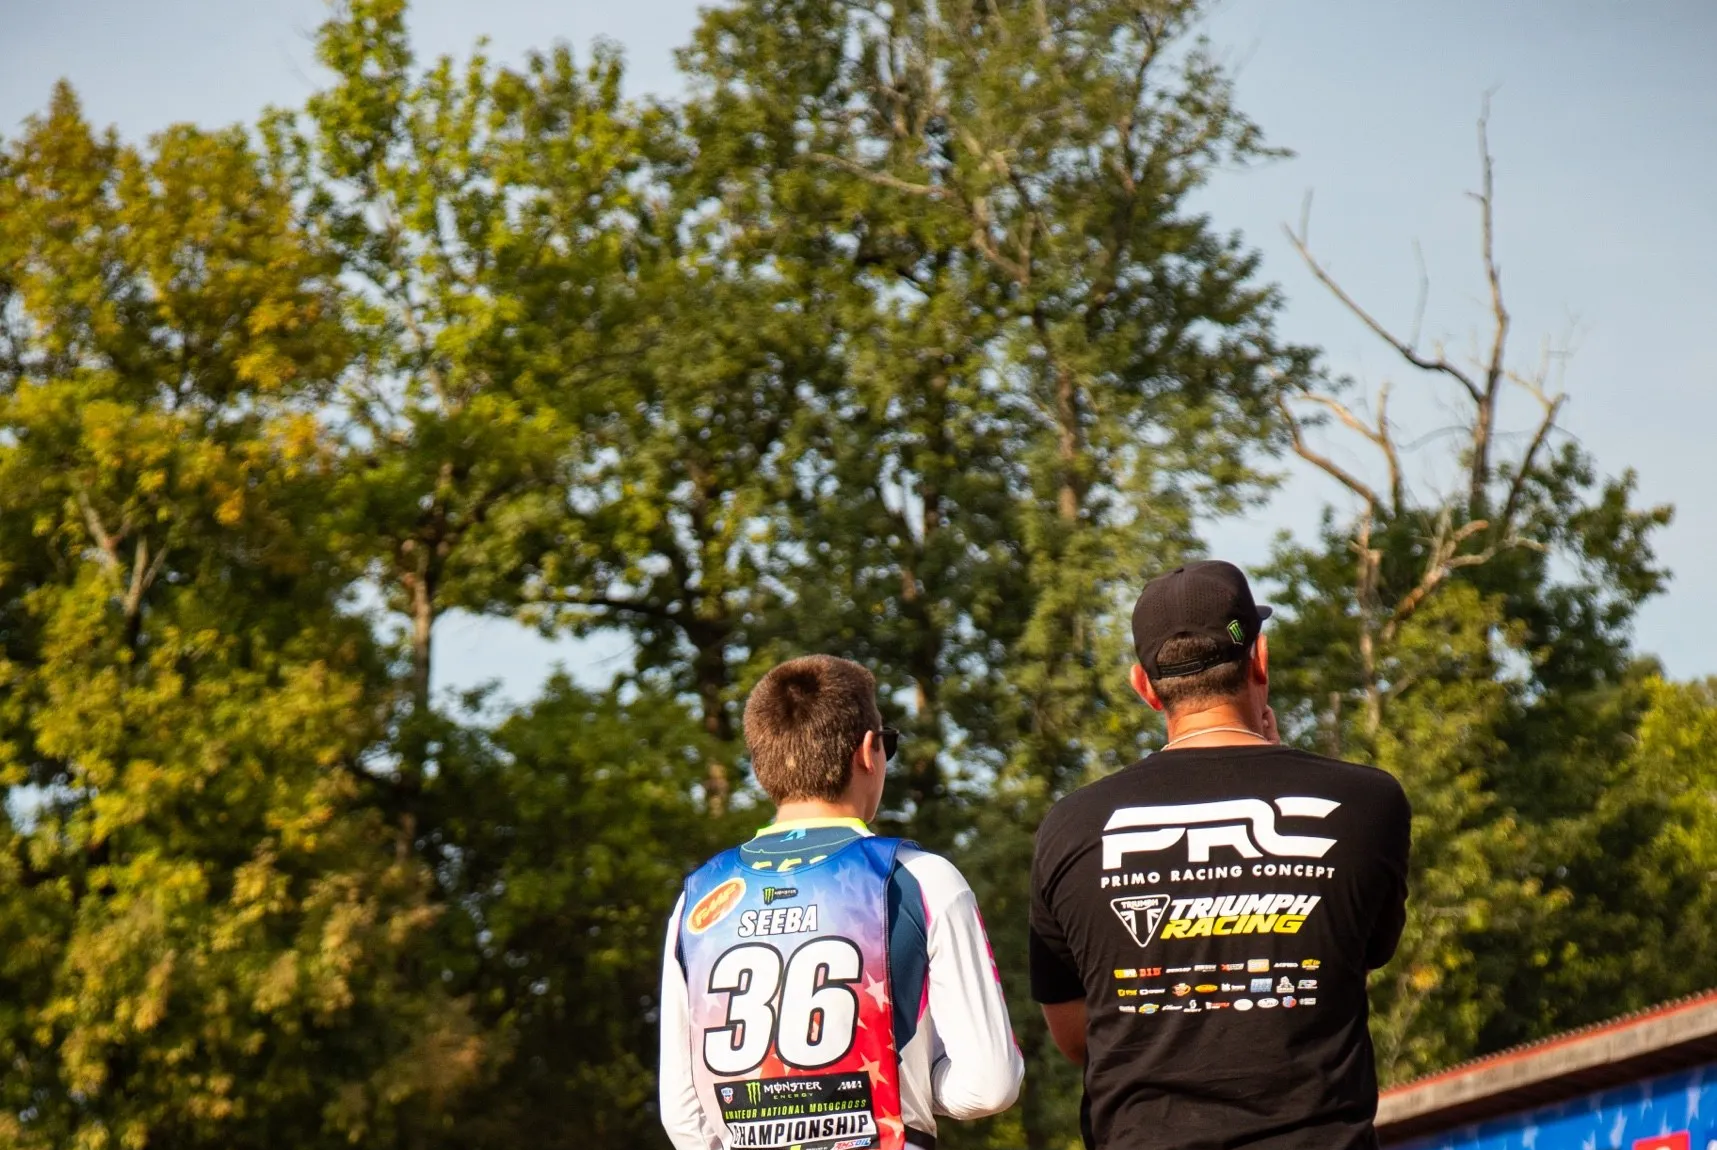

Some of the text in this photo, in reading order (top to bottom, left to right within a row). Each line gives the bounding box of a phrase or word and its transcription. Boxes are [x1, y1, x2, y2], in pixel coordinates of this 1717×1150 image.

[1100, 863, 1336, 889] PRIMO RACING CONCEPT
[1120, 898, 1159, 910] TRIUMPH
[1169, 893, 1322, 920] TRIUMPH
[738, 904, 818, 938] SEEBA
[1160, 914, 1307, 940] RACING
[703, 935, 864, 1077] 36
[763, 1081, 822, 1094] MONSTER
[837, 1080, 863, 1091] AMA
[725, 1099, 867, 1120] AMATEUR NATIONAL MOTOCROSS
[733, 1114, 869, 1146] CHAMPIONSHIP
